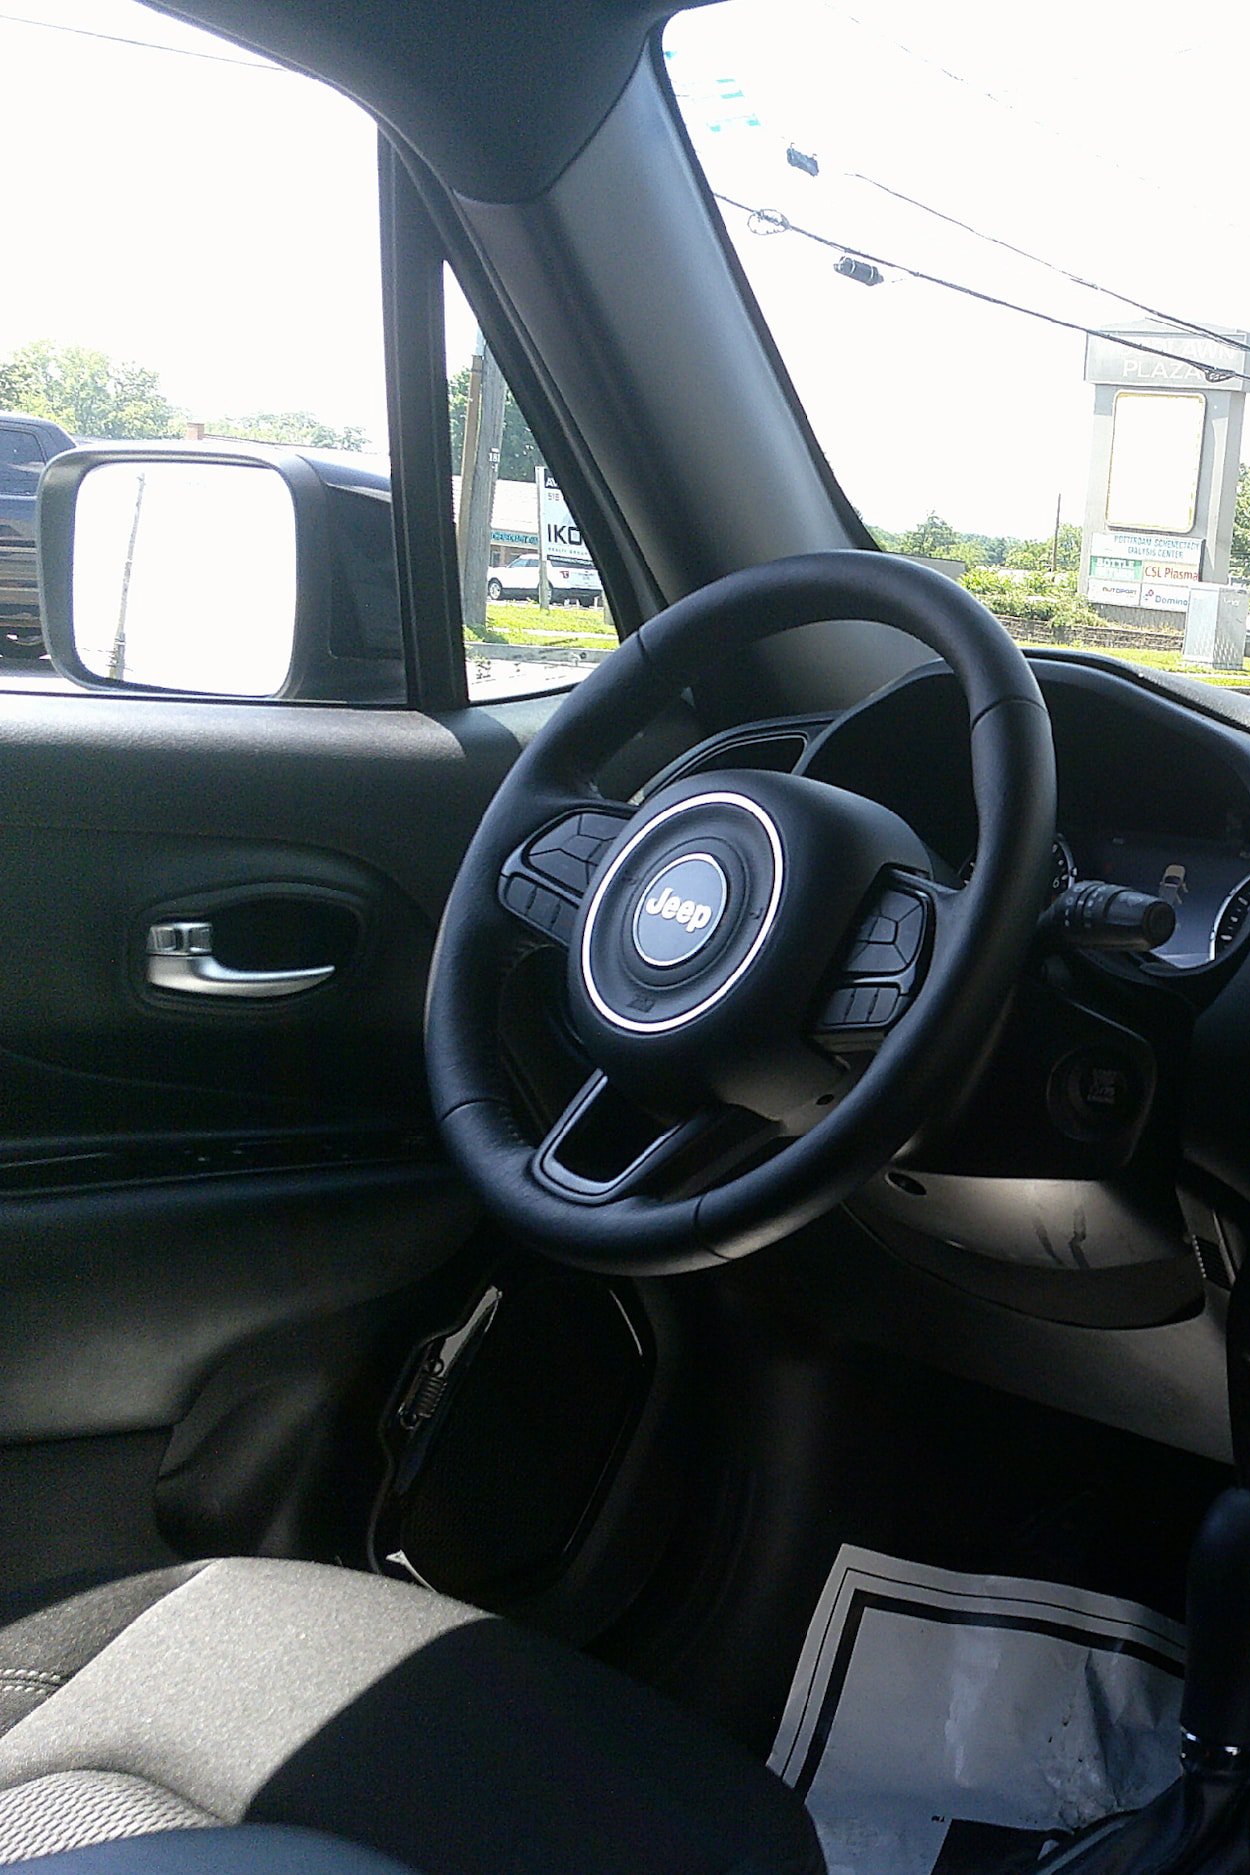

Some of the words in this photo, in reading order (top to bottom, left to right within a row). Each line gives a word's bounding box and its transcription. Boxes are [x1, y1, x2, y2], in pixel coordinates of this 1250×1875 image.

[1121, 360, 1203, 379] PLAZA
[547, 523, 584, 545] IKO
[1096, 557, 1135, 568] BOTTLE
[1144, 565, 1162, 578] CSL
[1164, 567, 1199, 581] Plasma
[646, 887, 711, 934] Jeep
